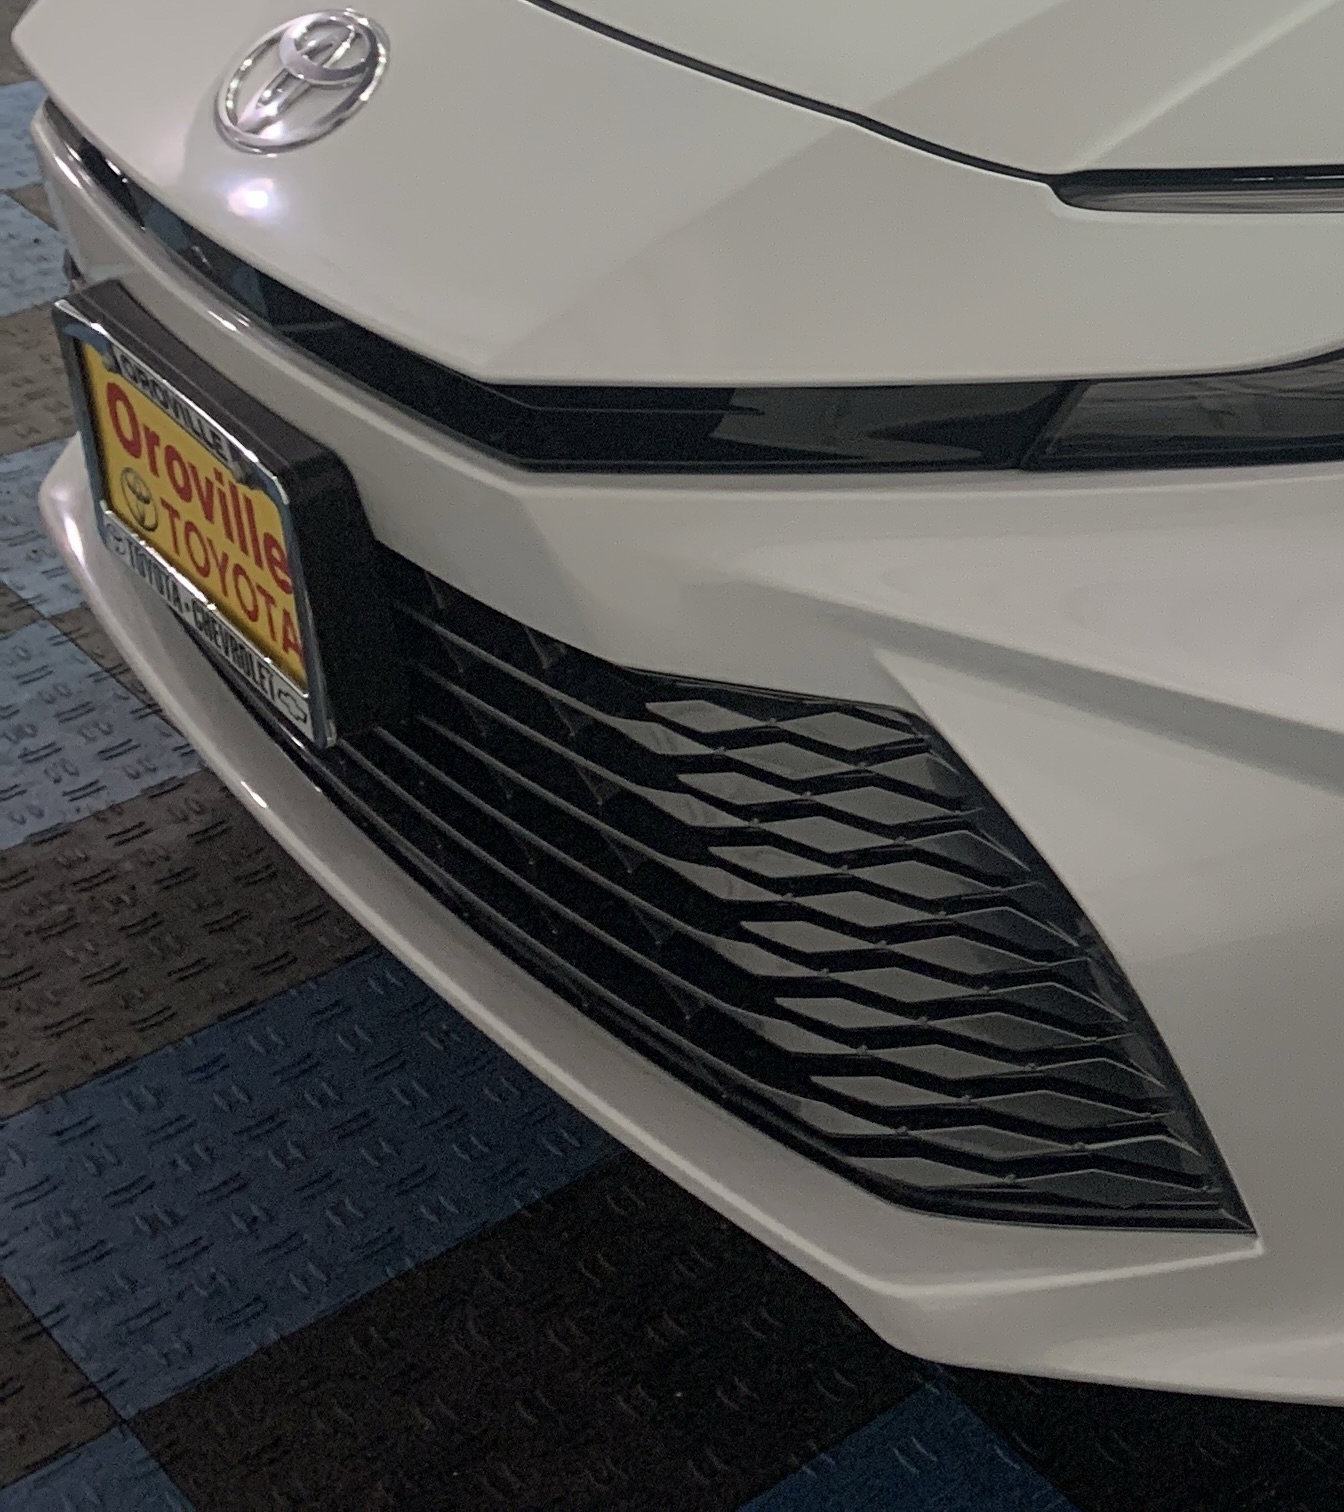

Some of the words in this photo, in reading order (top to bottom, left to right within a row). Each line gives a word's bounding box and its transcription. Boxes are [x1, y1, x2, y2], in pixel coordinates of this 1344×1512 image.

[106, 382, 293, 595] Oroville
[162, 498, 304, 660] TOYOTA
[191, 598, 276, 702] CHEVROLET
